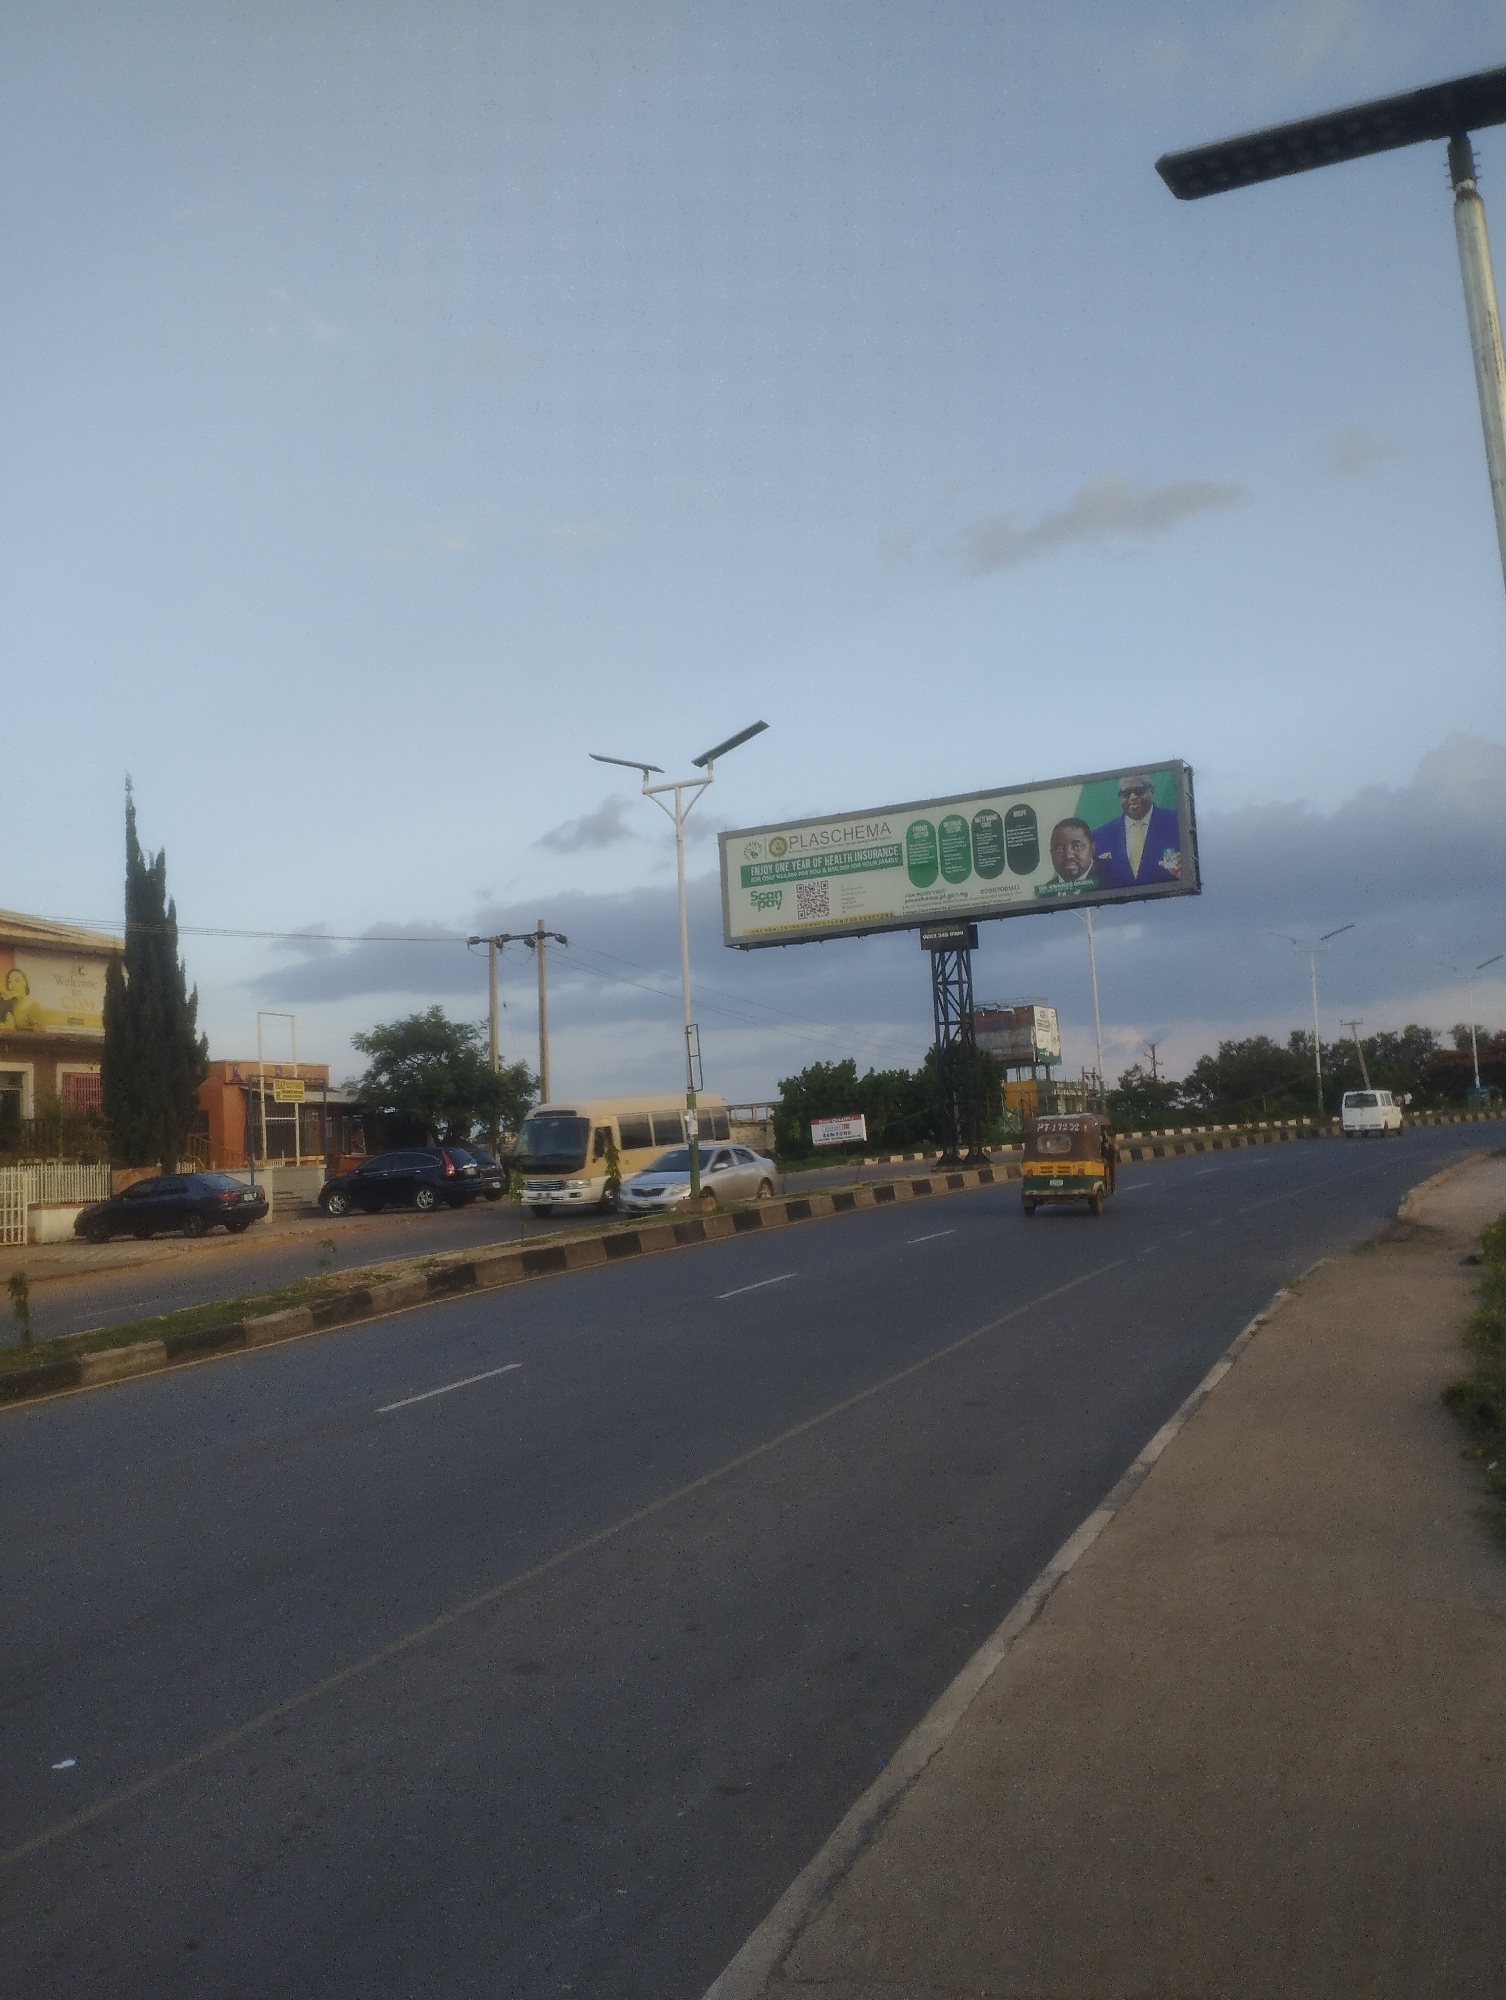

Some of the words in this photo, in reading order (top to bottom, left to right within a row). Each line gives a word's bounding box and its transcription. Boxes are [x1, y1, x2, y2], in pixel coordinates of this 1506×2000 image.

[789, 822, 891, 849] PLASCHEMA
[751, 864, 773, 876] ENJOY
[775, 862, 789, 873] ONE
[791, 859, 811, 871] YEAR
[813, 857, 823, 868] OF
[825, 853, 852, 866] HEALTH
[854, 846, 898, 862] INSURANCE
[879, 857, 898, 865] FAMILY
[750, 890, 782, 901] Scan
[757, 899, 782, 912] pay
[53, 974, 98, 989] Welcome
[61, 997, 96, 1012] CDM
